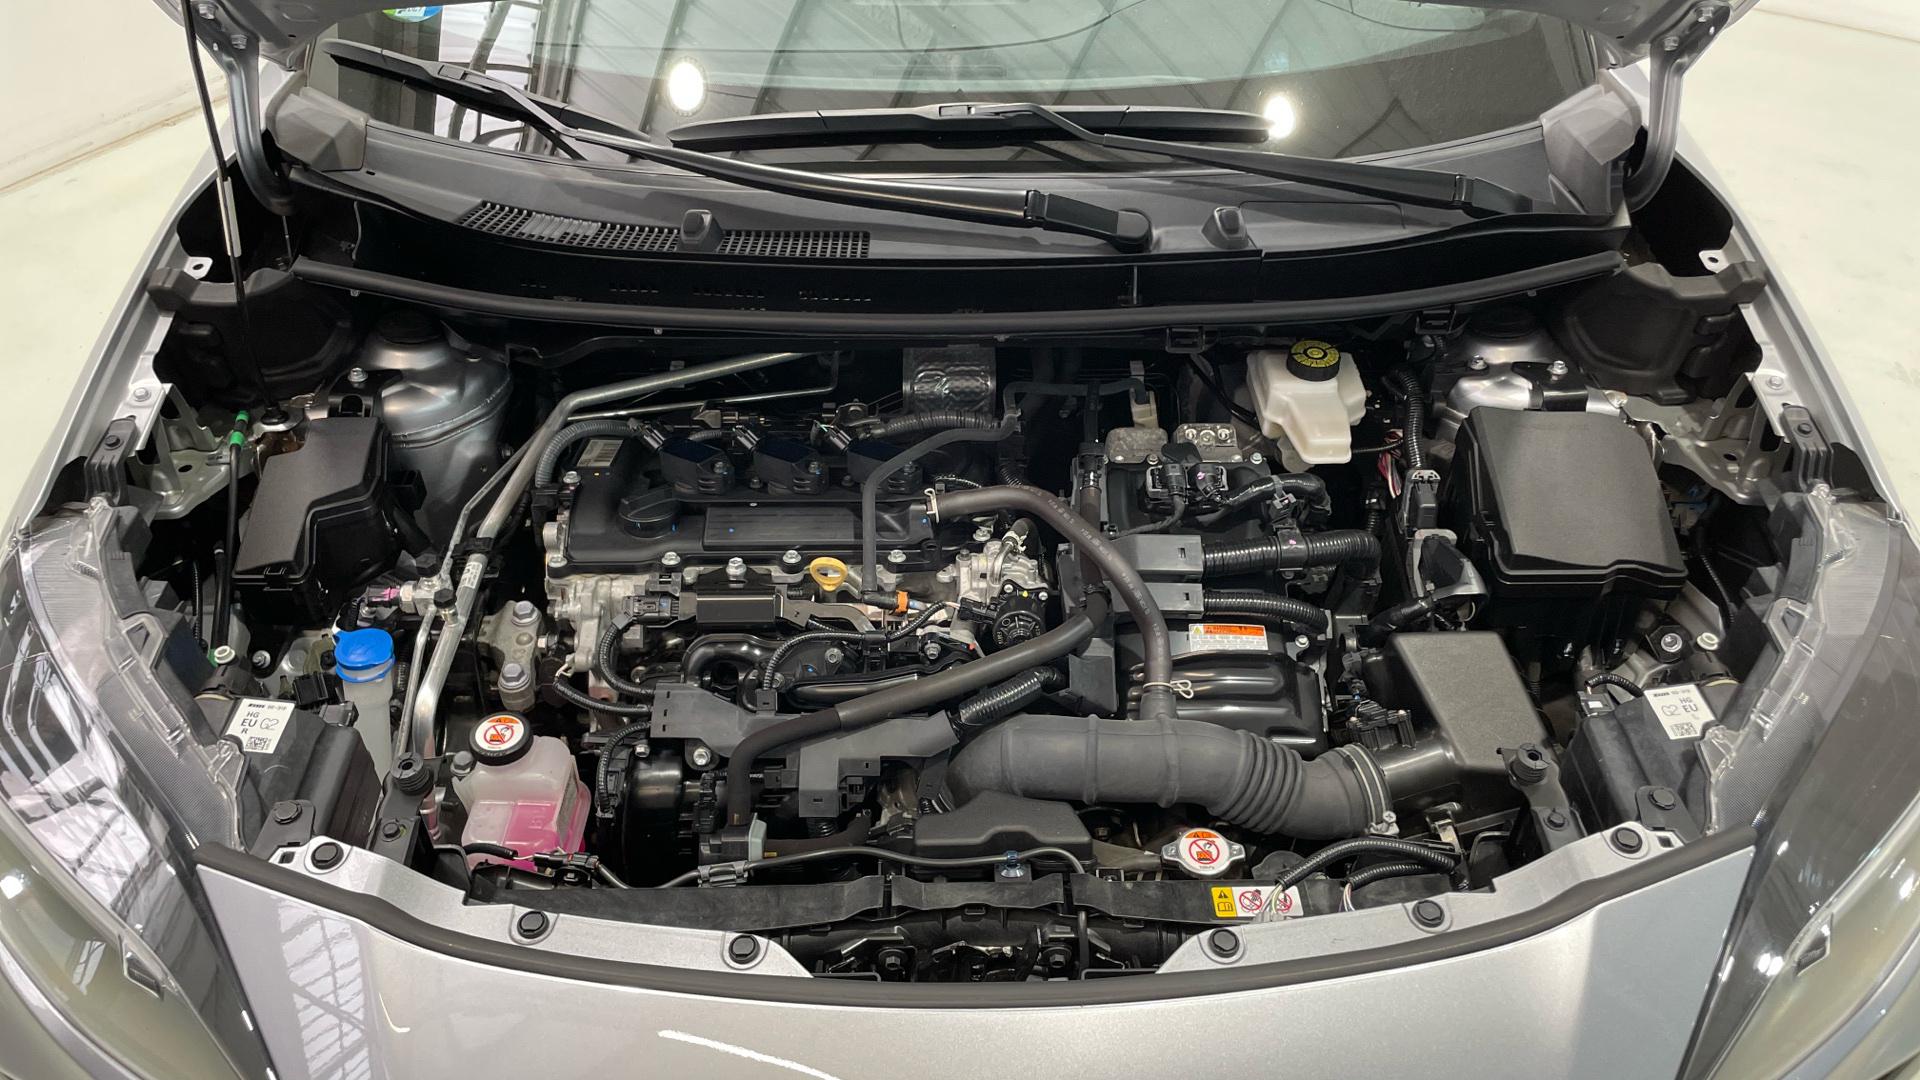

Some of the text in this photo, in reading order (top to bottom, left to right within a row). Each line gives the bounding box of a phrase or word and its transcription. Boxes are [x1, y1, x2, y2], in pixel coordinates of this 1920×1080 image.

[1682, 703, 1699, 713] EU
[246, 711, 260, 719] HG
[240, 718, 258, 728] EU
[260, 717, 279, 731] G2
